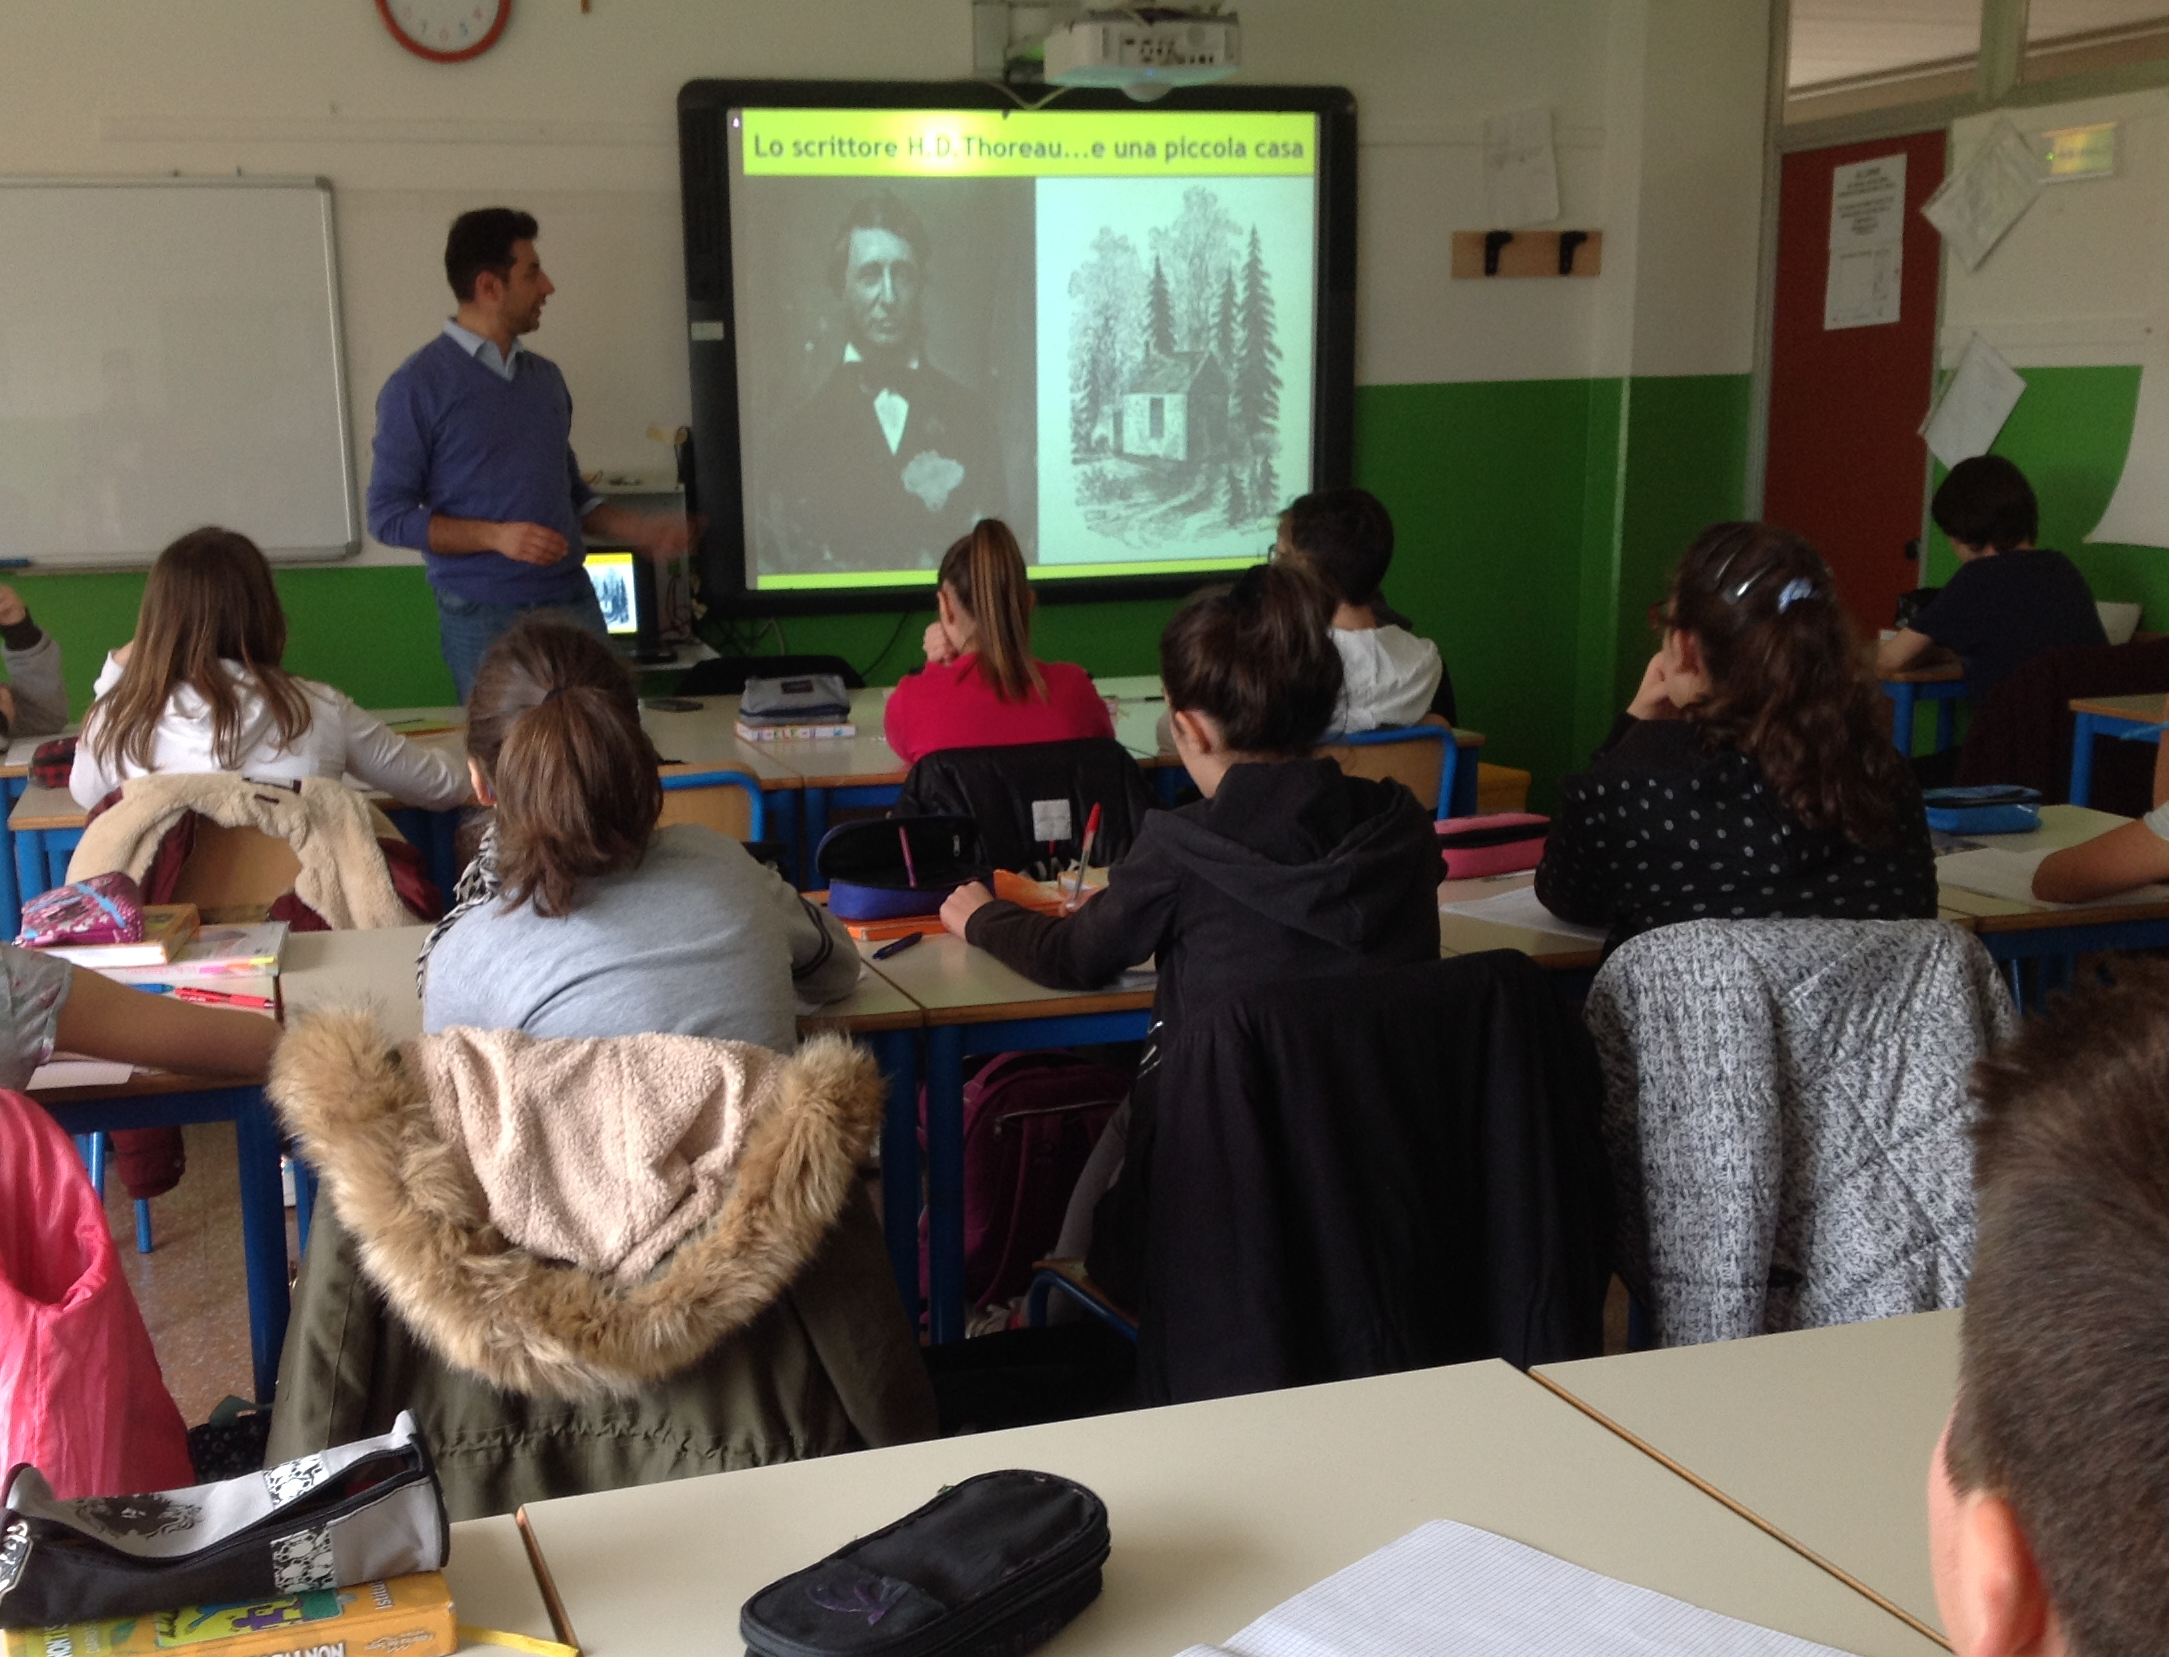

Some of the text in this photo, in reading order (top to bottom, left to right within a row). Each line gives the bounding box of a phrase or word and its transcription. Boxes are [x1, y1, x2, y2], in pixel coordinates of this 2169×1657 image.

[755, 131, 784, 158] Lo
[792, 134, 898, 159] scrittore
[1114, 140, 1157, 159] una
[1165, 135, 1248, 164] piccola
[1255, 140, 1305, 159] casa
